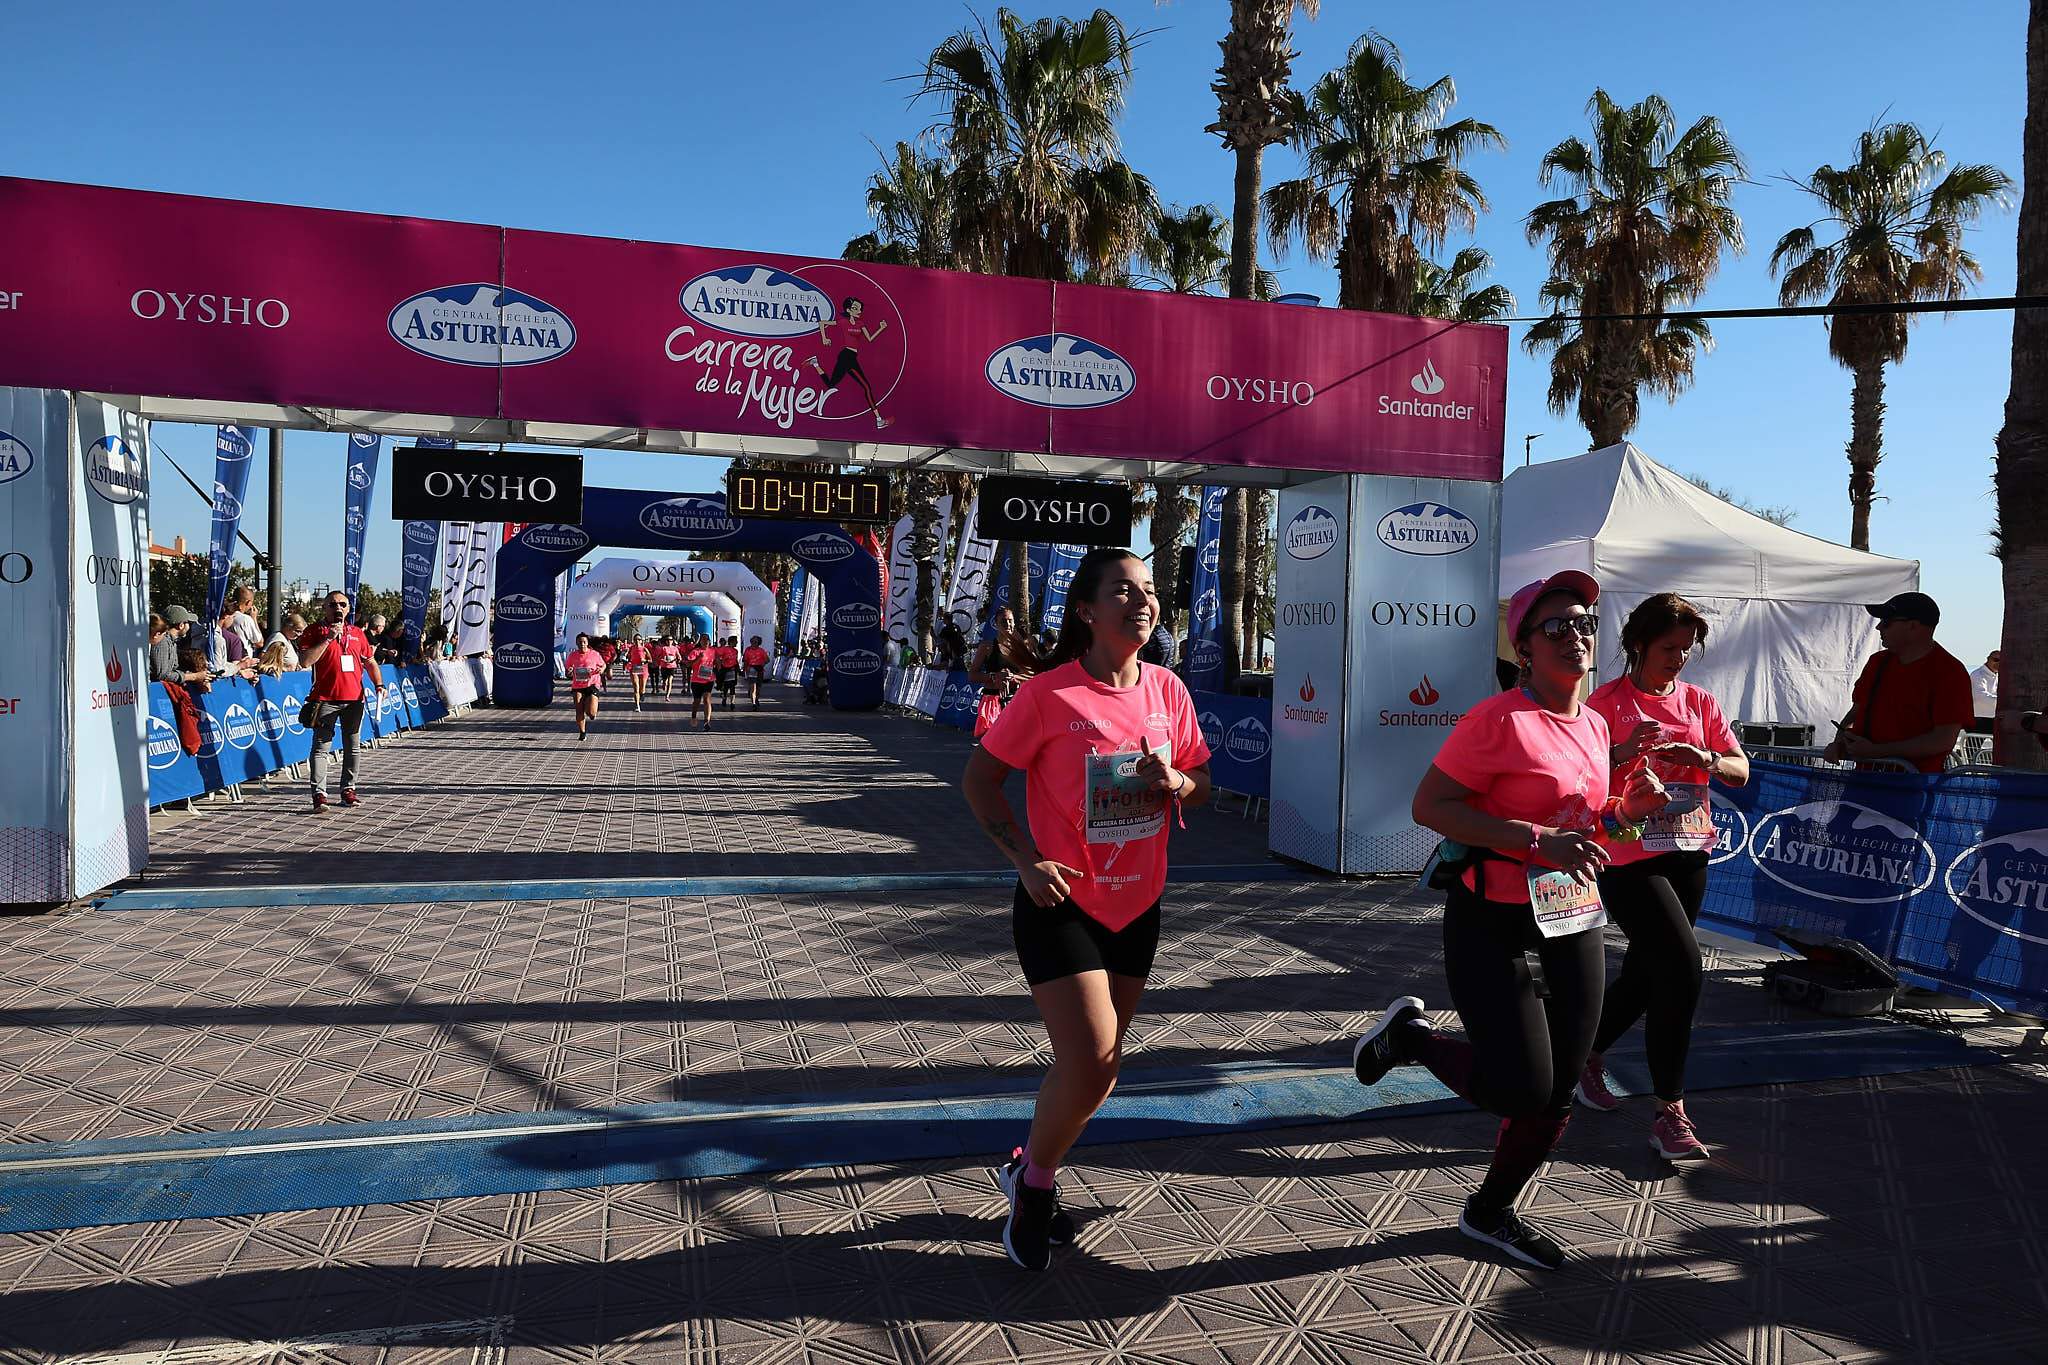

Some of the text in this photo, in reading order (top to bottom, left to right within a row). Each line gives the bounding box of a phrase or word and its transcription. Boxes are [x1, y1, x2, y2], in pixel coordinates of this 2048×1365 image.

[692, 287, 823, 323] ASTURIANA
[716, 285, 819, 303] CENTRAL LECHERA
[130, 289, 290, 328] OYSHO
[433, 308, 492, 320] CENTRAL
[403, 308, 563, 349] ASTURIANA
[665, 325, 792, 369] Carrera
[997, 356, 1125, 392] ASTURIANA
[1021, 356, 1120, 371] CENTRAL LECHERA
[696, 368, 839, 430] de la Mujer
[1206, 375, 1316, 407] OYSHO
[1378, 395, 1475, 421] Santander
[90, 455, 142, 491] ASTURIANA
[424, 471, 557, 503] OYSHO
[738, 477, 879, 515] 00:40:47
[648, 508, 736, 531] ASTURIANA
[1003, 496, 1112, 526] OYSHO
[525, 532, 584, 547] ASTURIANA
[1287, 528, 1335, 549] ASTURIANA
[1383, 519, 1472, 544] ASTURIANA
[797, 542, 852, 556] ASTURIANA
[87, 554, 143, 588] OYSHO
[442, 522, 470, 625] OYSH
[462, 529, 488, 628] OYSH
[632, 565, 715, 584] OYSHO
[952, 514, 993, 635] OYSH
[582, 581, 608, 590] OYSHO
[736, 585, 762, 593] OYSHO
[1282, 601, 1336, 626] OYSHO
[1371, 601, 1477, 627] OYSHO
[91, 688, 139, 710] Santander
[1070, 719, 1112, 732] OYSHO
[1284, 704, 1329, 725] Santander
[148, 738, 179, 757] TURIANA
[1092, 819, 1117, 828] CARRERA
[1098, 828, 1130, 839] OYSHO
[1758, 824, 1917, 888] ASTURIANA
